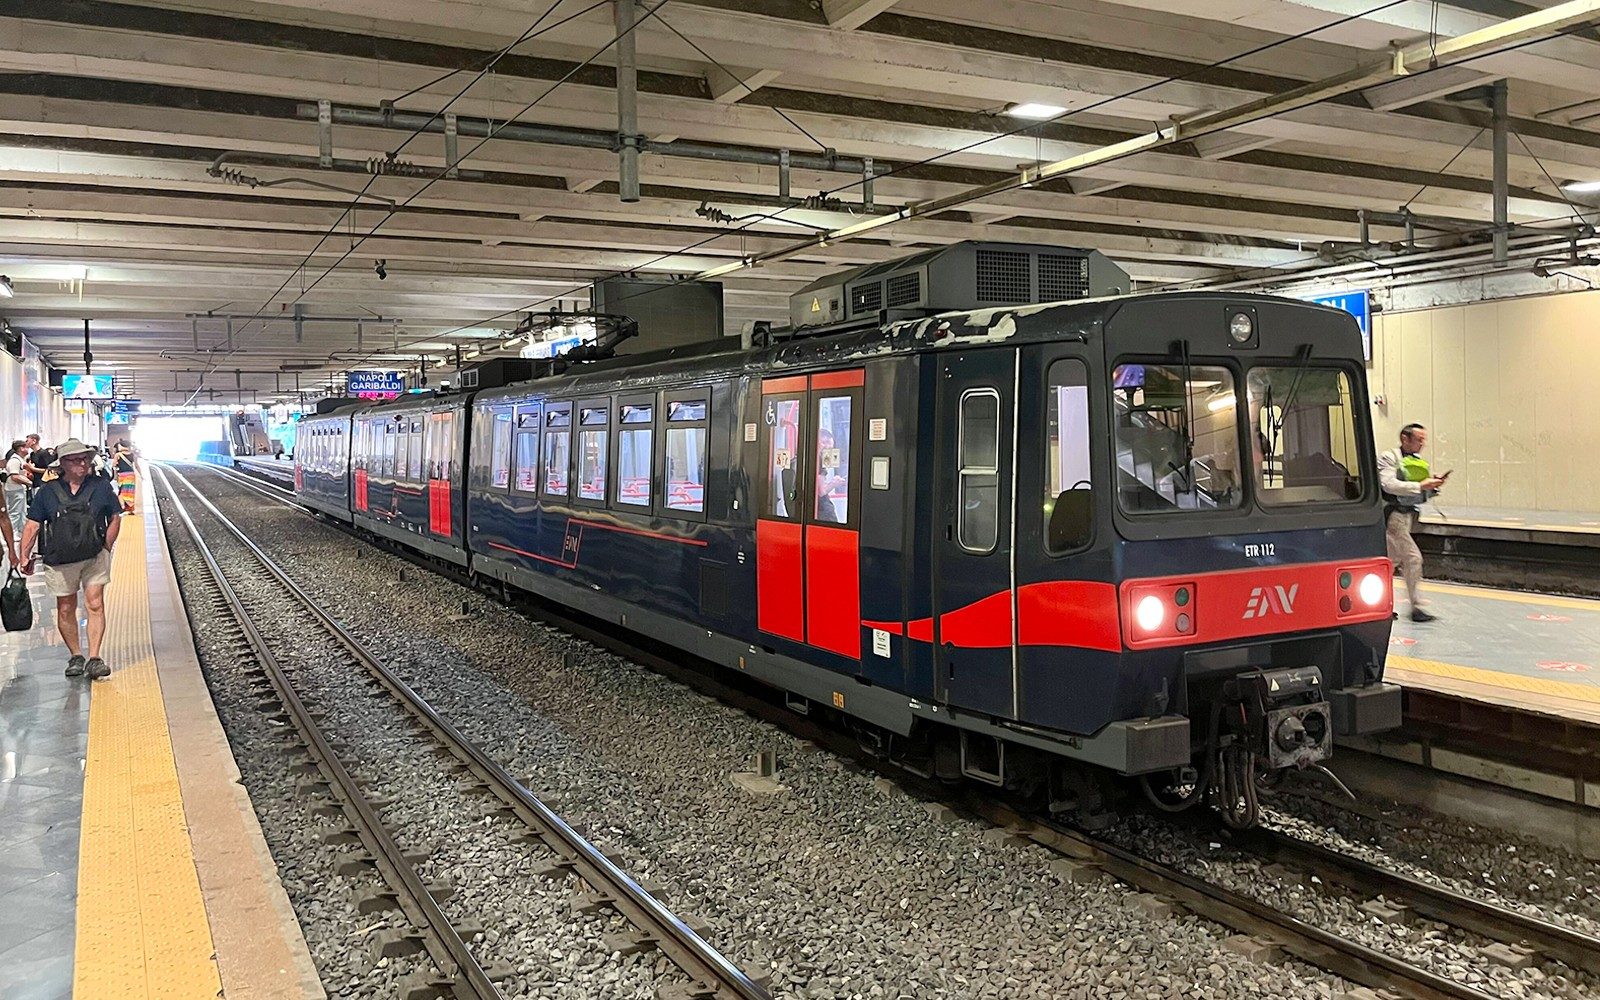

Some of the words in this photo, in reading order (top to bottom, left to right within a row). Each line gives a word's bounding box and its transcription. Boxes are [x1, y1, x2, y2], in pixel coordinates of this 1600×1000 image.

[1245, 544, 1260, 557] ETR
[1260, 543, 1275, 556] 112
[1242, 583, 1299, 619] EAV
